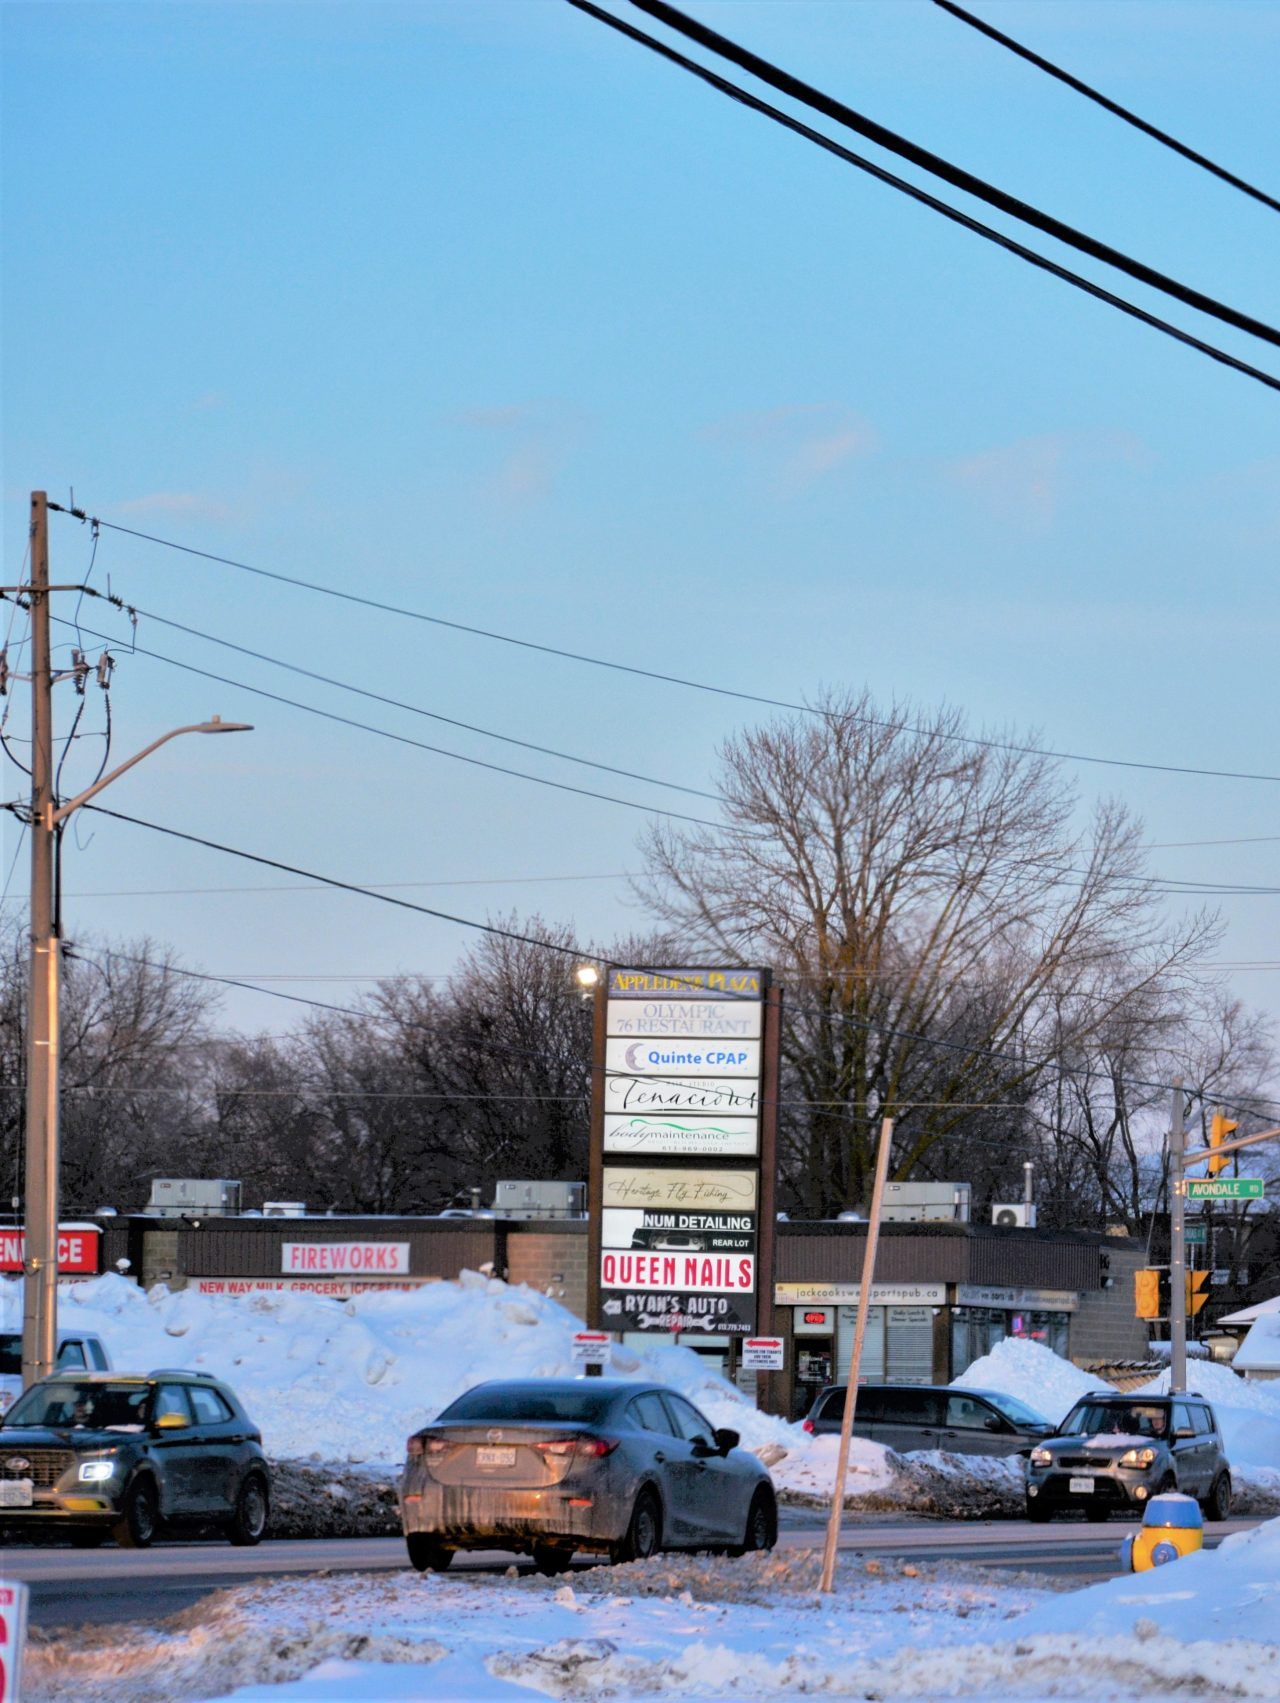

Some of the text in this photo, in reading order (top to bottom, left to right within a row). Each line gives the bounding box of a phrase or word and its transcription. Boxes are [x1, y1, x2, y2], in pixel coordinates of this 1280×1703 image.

[708, 971, 759, 992] PLAZA
[643, 1004, 725, 1018] OLYMPIC
[617, 1019, 751, 1034] 76 RESTAURANT
[648, 1051, 748, 1064] Quinte CPAP
[1192, 1184, 1240, 1195] AVONDALE
[644, 1214, 751, 1230] NUM DETAILING
[291, 1247, 399, 1269] FIREWORKS
[603, 1255, 751, 1288] QUEEN NAILS
[200, 1282, 224, 1293] NEW
[228, 1282, 252, 1294] WAY
[625, 1295, 728, 1314] RYAN'S AUTO
[659, 1313, 693, 1328] REPAIR
